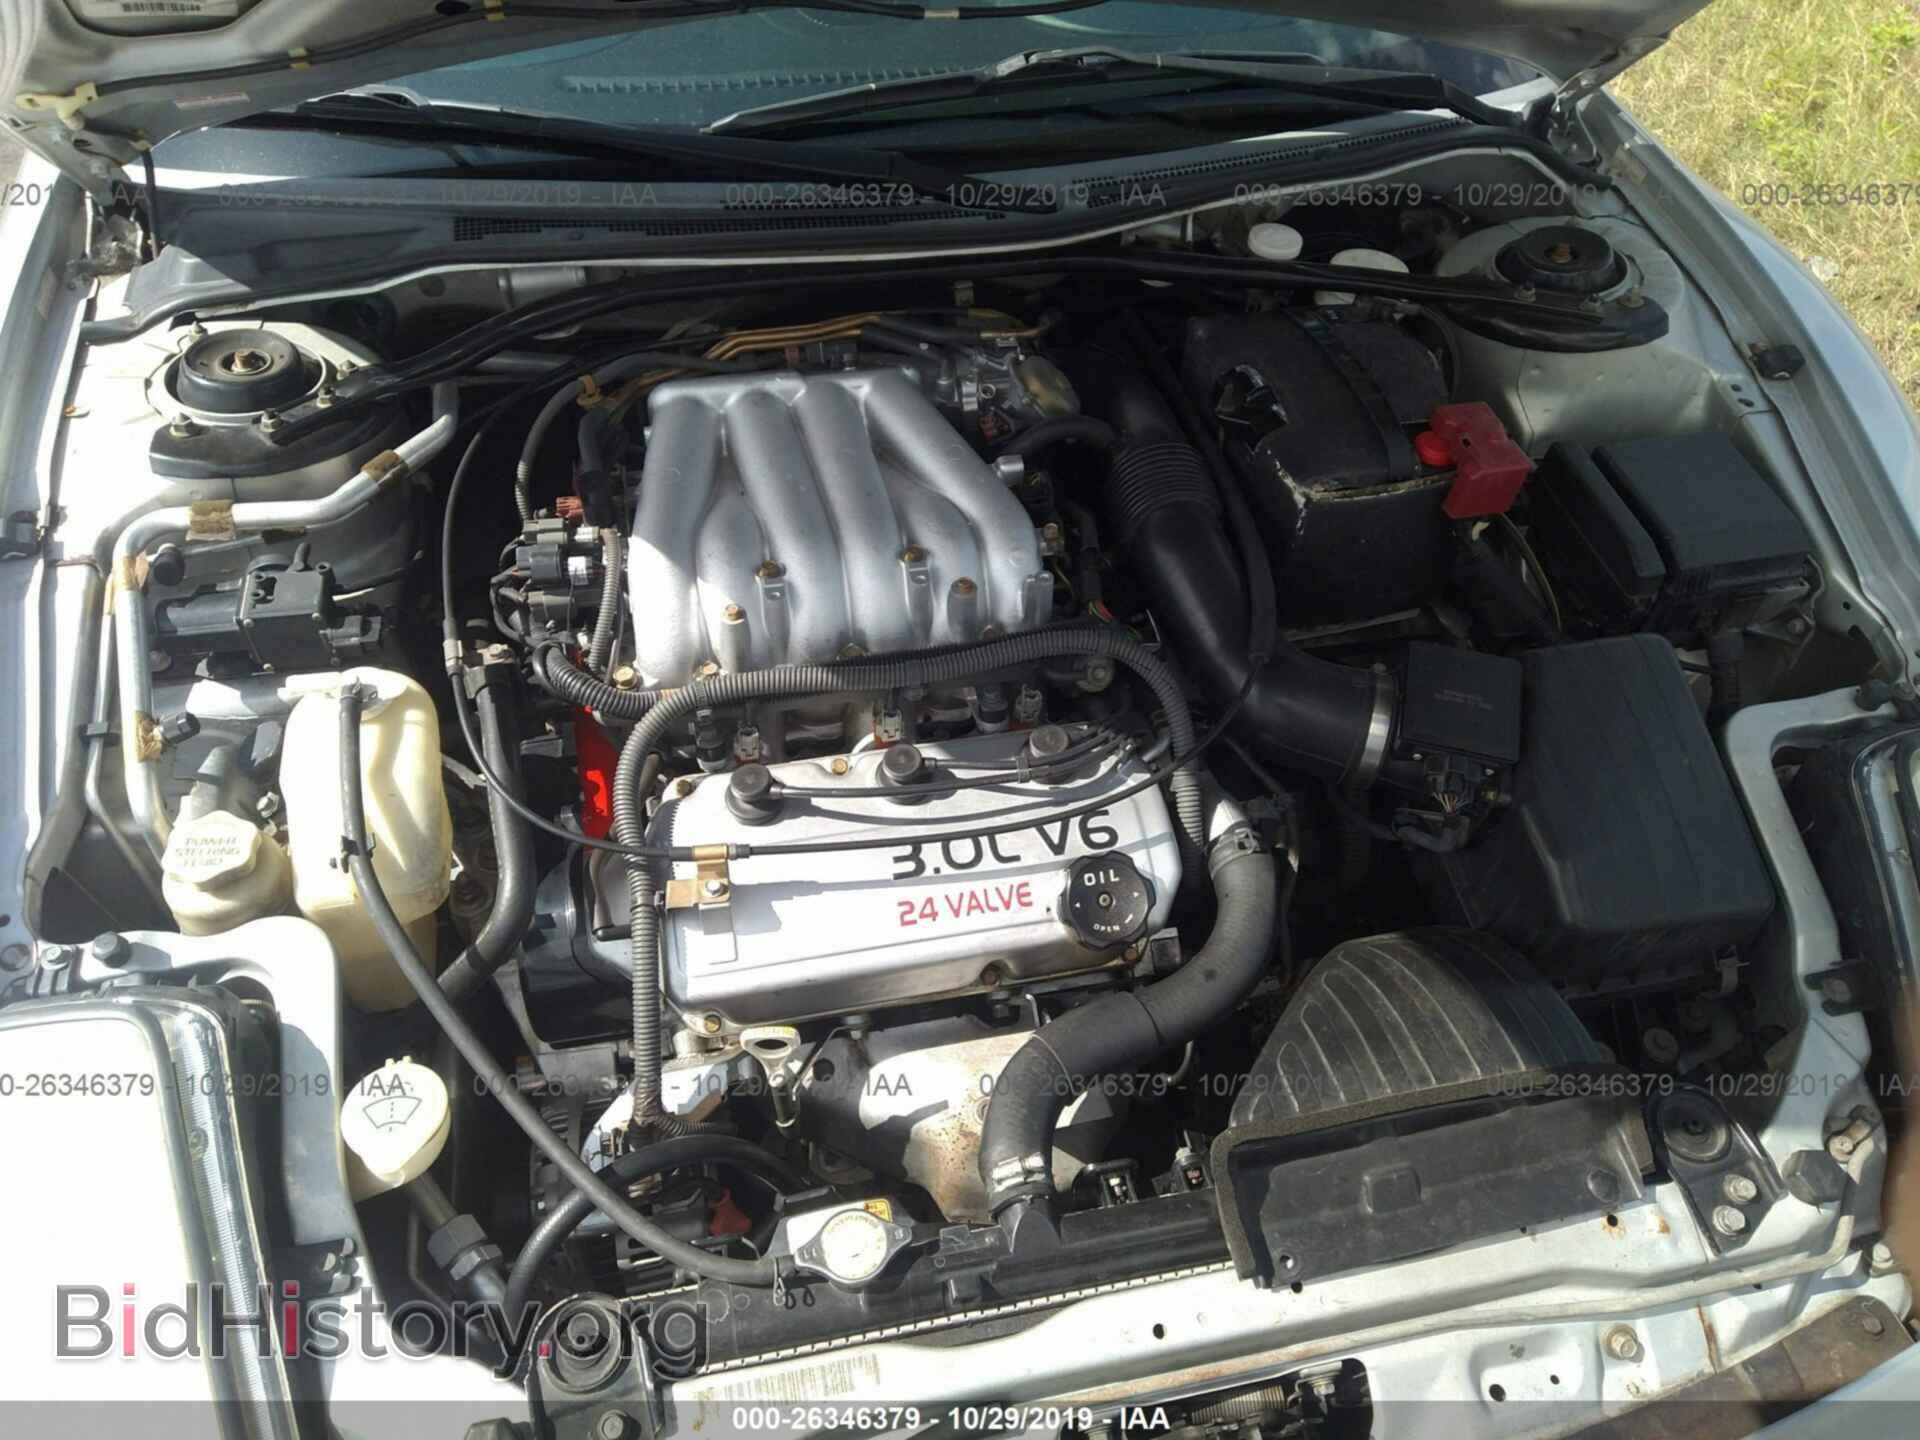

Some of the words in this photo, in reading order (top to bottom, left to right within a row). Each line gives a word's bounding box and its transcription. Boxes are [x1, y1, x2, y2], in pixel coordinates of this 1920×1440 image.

[1035, 809, 1119, 857] V6
[1083, 868, 1121, 887] OIL
[897, 896, 939, 927] 24
[945, 881, 1034, 919] VALVE
[1092, 922, 1121, 934] OPEN
